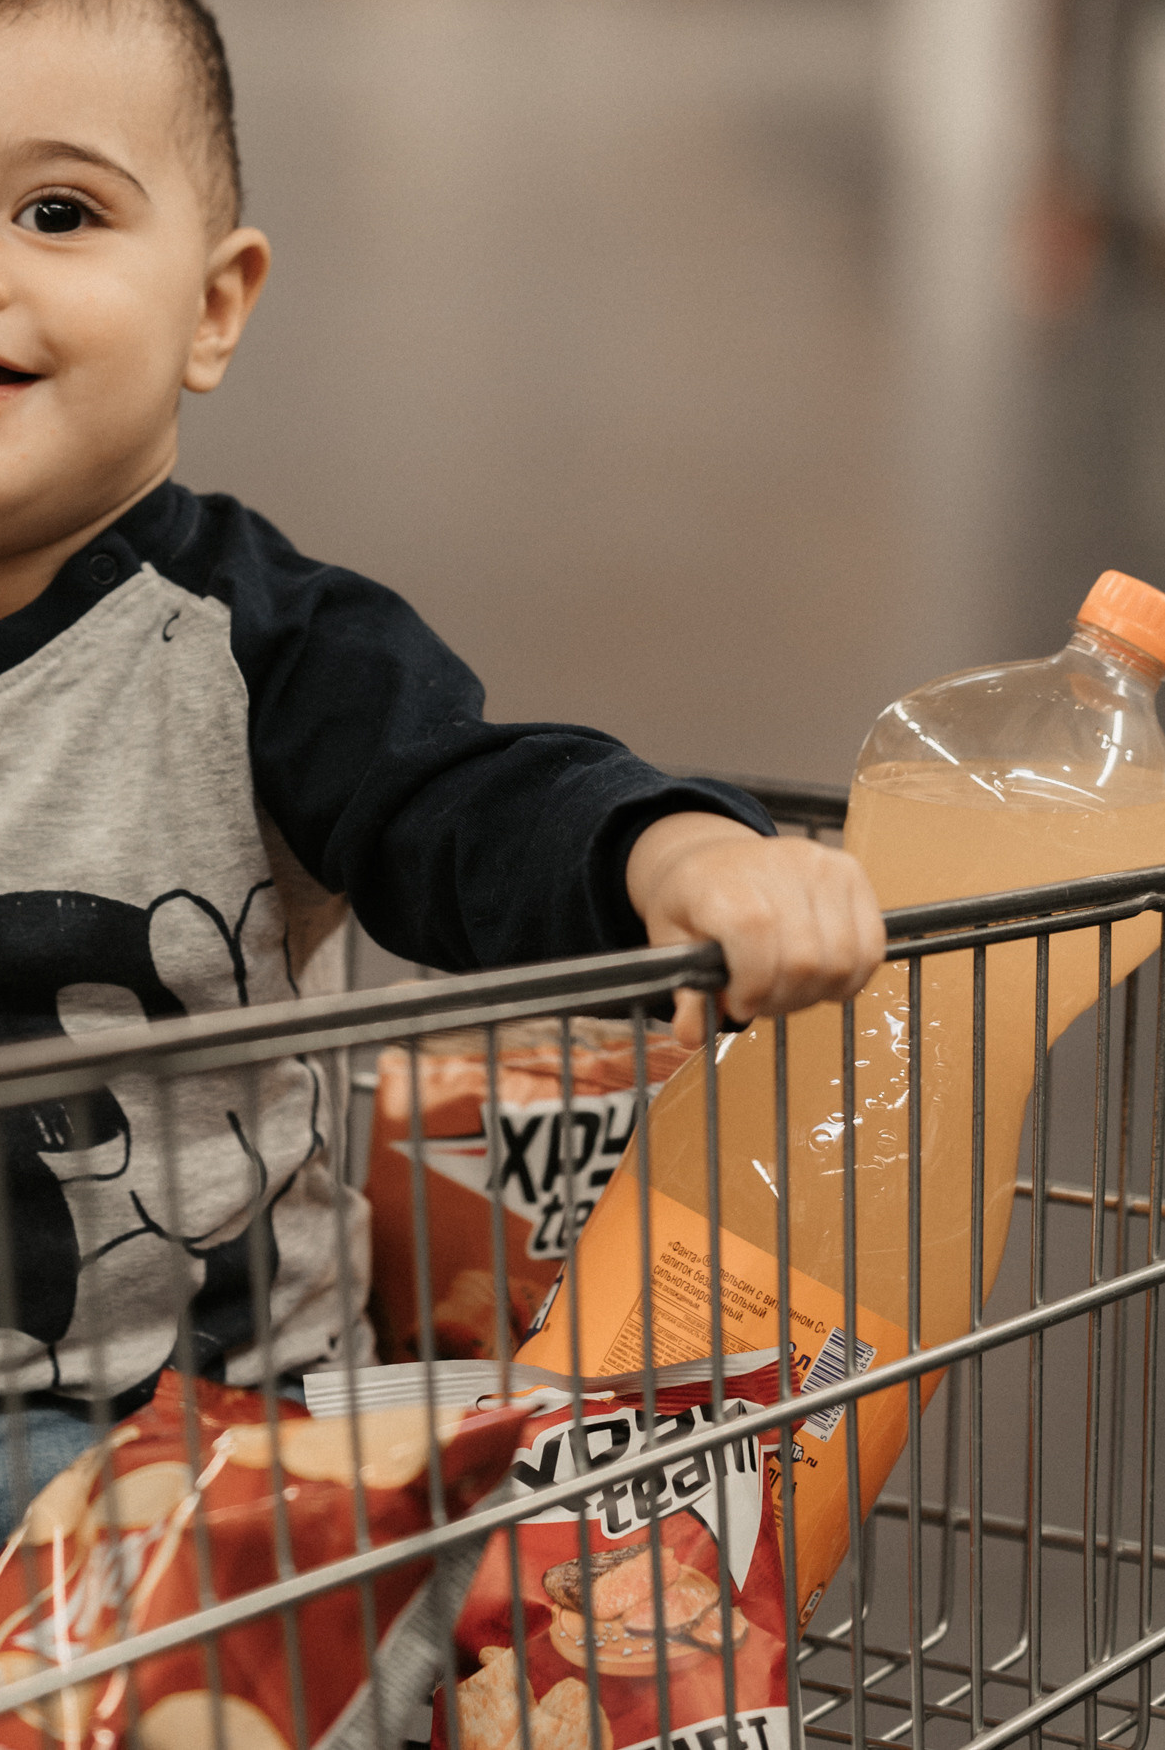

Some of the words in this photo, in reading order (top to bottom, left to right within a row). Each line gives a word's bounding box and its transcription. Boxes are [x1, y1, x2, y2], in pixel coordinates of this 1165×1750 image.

[659, 1252, 692, 1278] напиток
[668, 1241, 701, 1263] «Фанта»
[719, 1267, 755, 1296] пельсин
[796, 1354, 812, 1371] л
